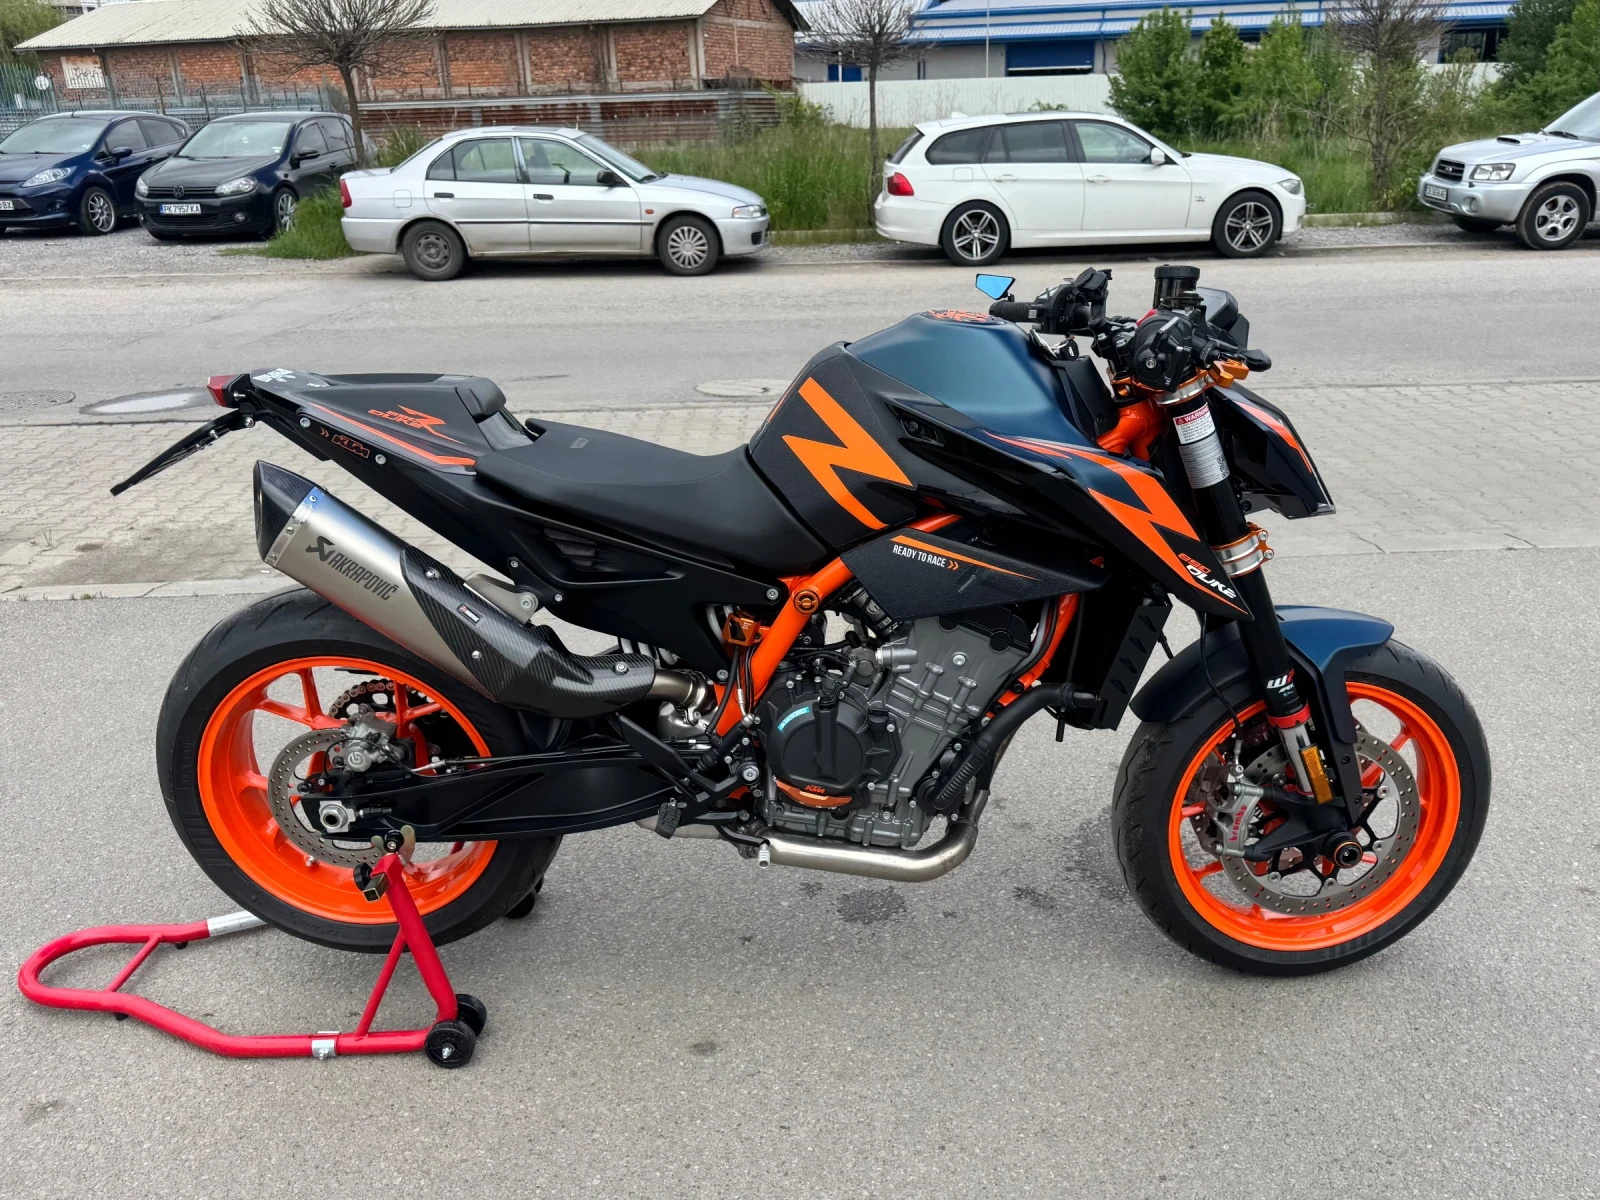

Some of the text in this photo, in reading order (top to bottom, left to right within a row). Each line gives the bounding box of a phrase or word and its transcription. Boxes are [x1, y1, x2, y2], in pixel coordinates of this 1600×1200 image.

[893, 544, 946, 568] READY TO RACE
[328, 552, 400, 601] AKRAPOVIČ
[1186, 564, 1237, 599] DUKE
[1229, 804, 1248, 842] brembo
